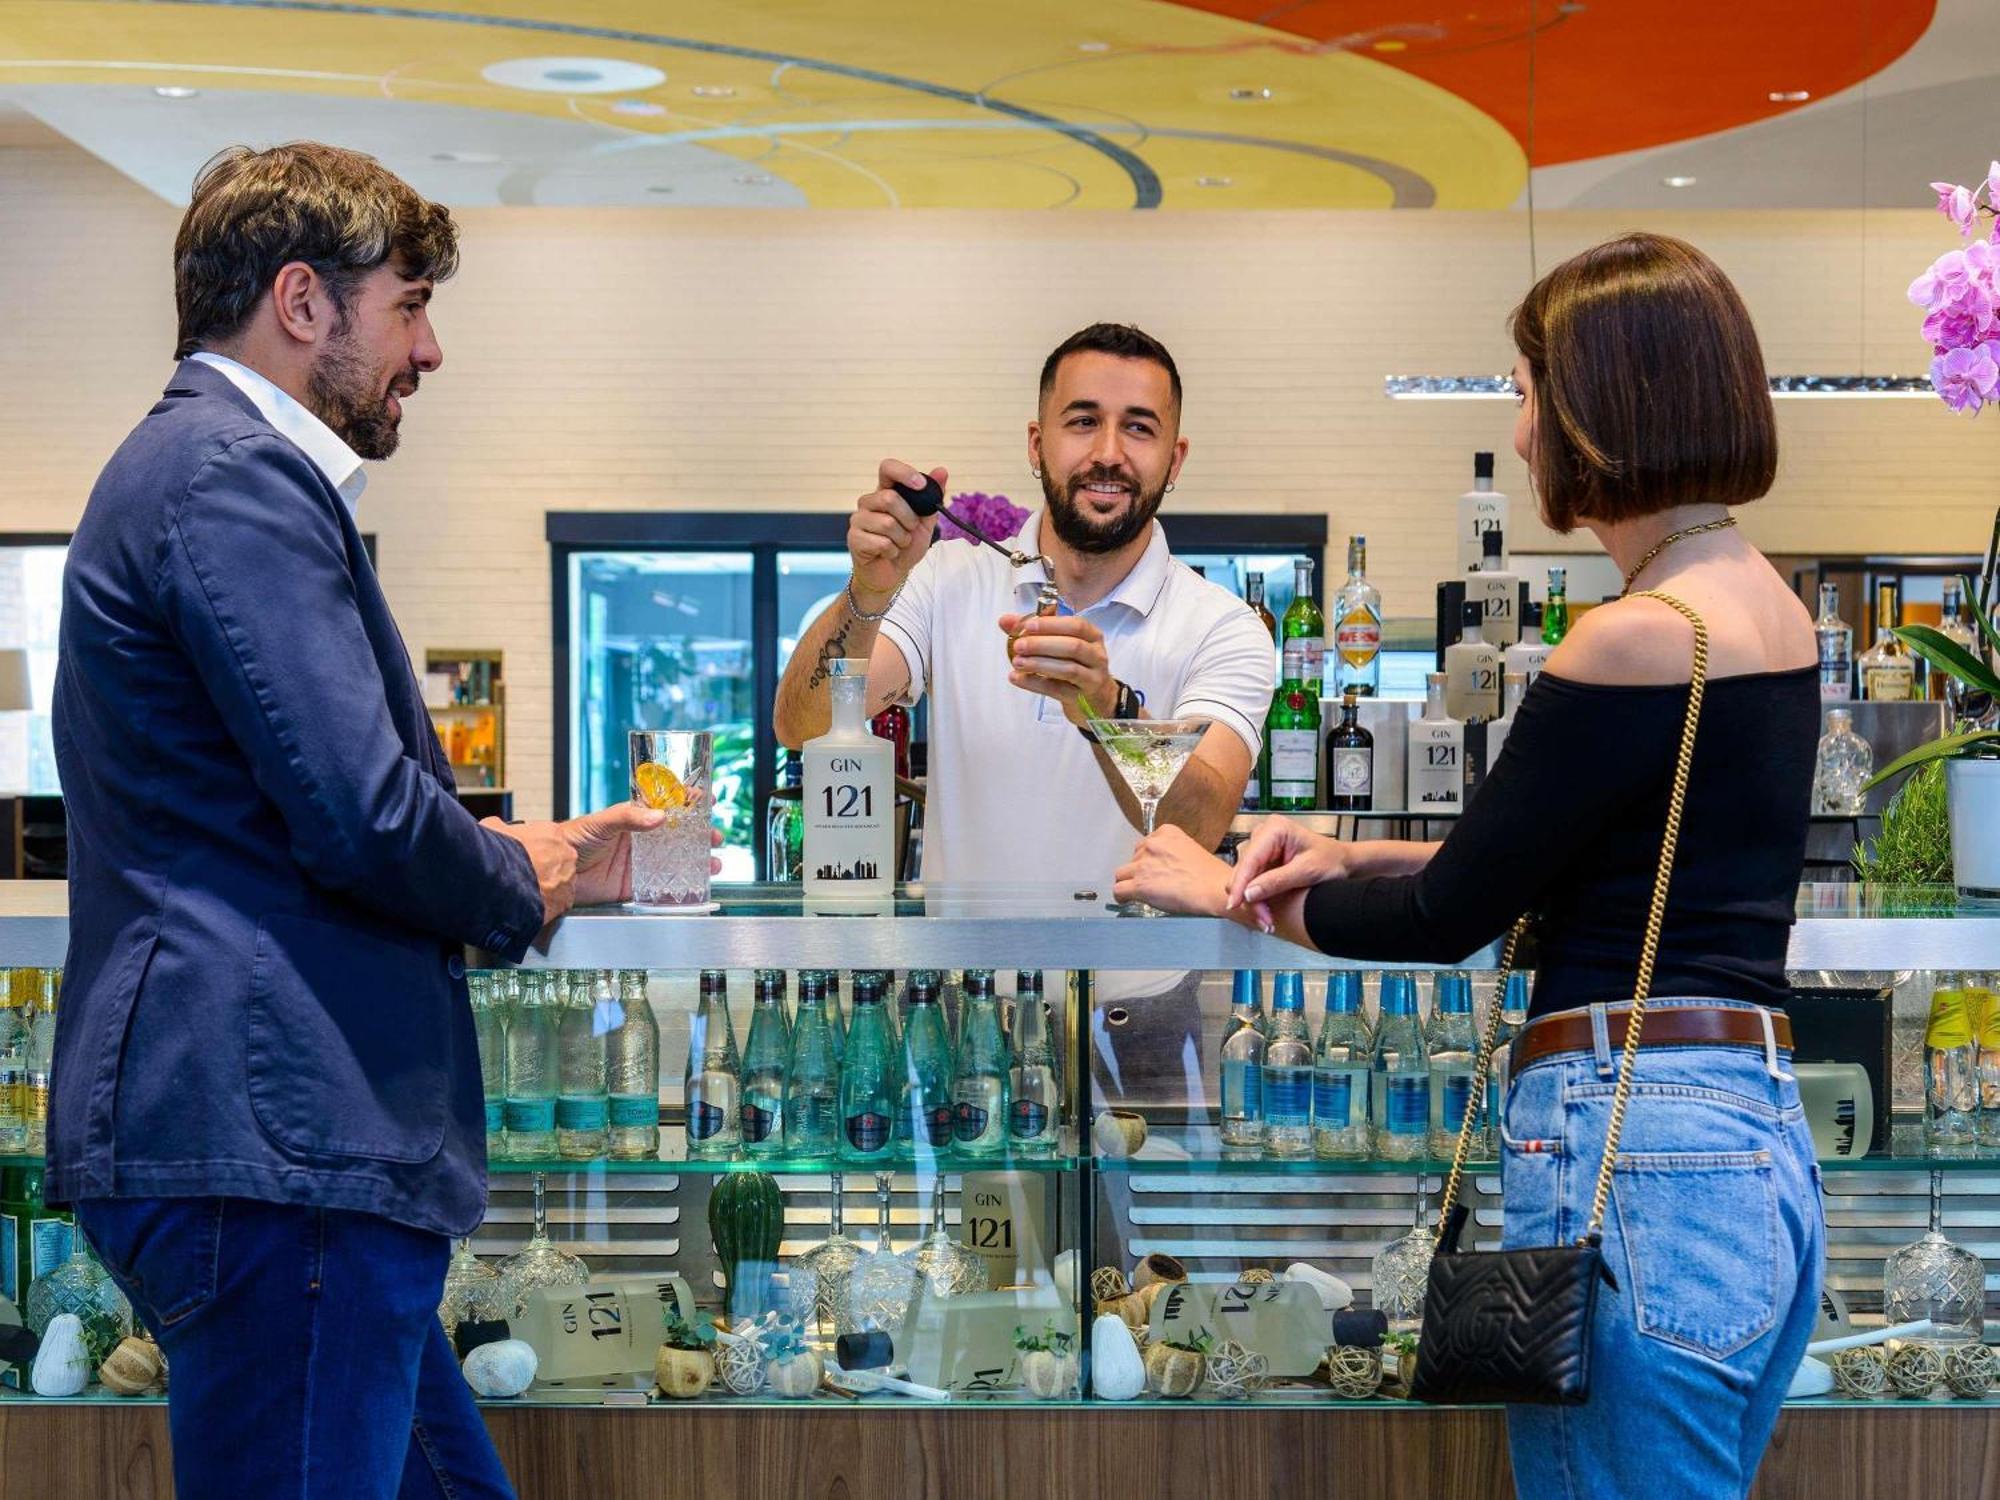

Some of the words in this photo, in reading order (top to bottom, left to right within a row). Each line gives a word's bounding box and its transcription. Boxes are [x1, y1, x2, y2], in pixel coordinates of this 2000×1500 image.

[1477, 503, 1496, 512] GIN
[1487, 582, 1506, 591] GIN
[1483, 598, 1511, 617] 121
[1476, 654, 1493, 664] GIN
[1471, 669, 1497, 689] 121
[1431, 729, 1451, 738] GIN
[1426, 745, 1456, 765] 121
[830, 758, 863, 773] GIN
[821, 784, 872, 817] 121
[975, 1192, 1002, 1207] GIN
[968, 1217, 1012, 1249] 121
[562, 1303, 578, 1334] GIN
[585, 1292, 622, 1341] 121
